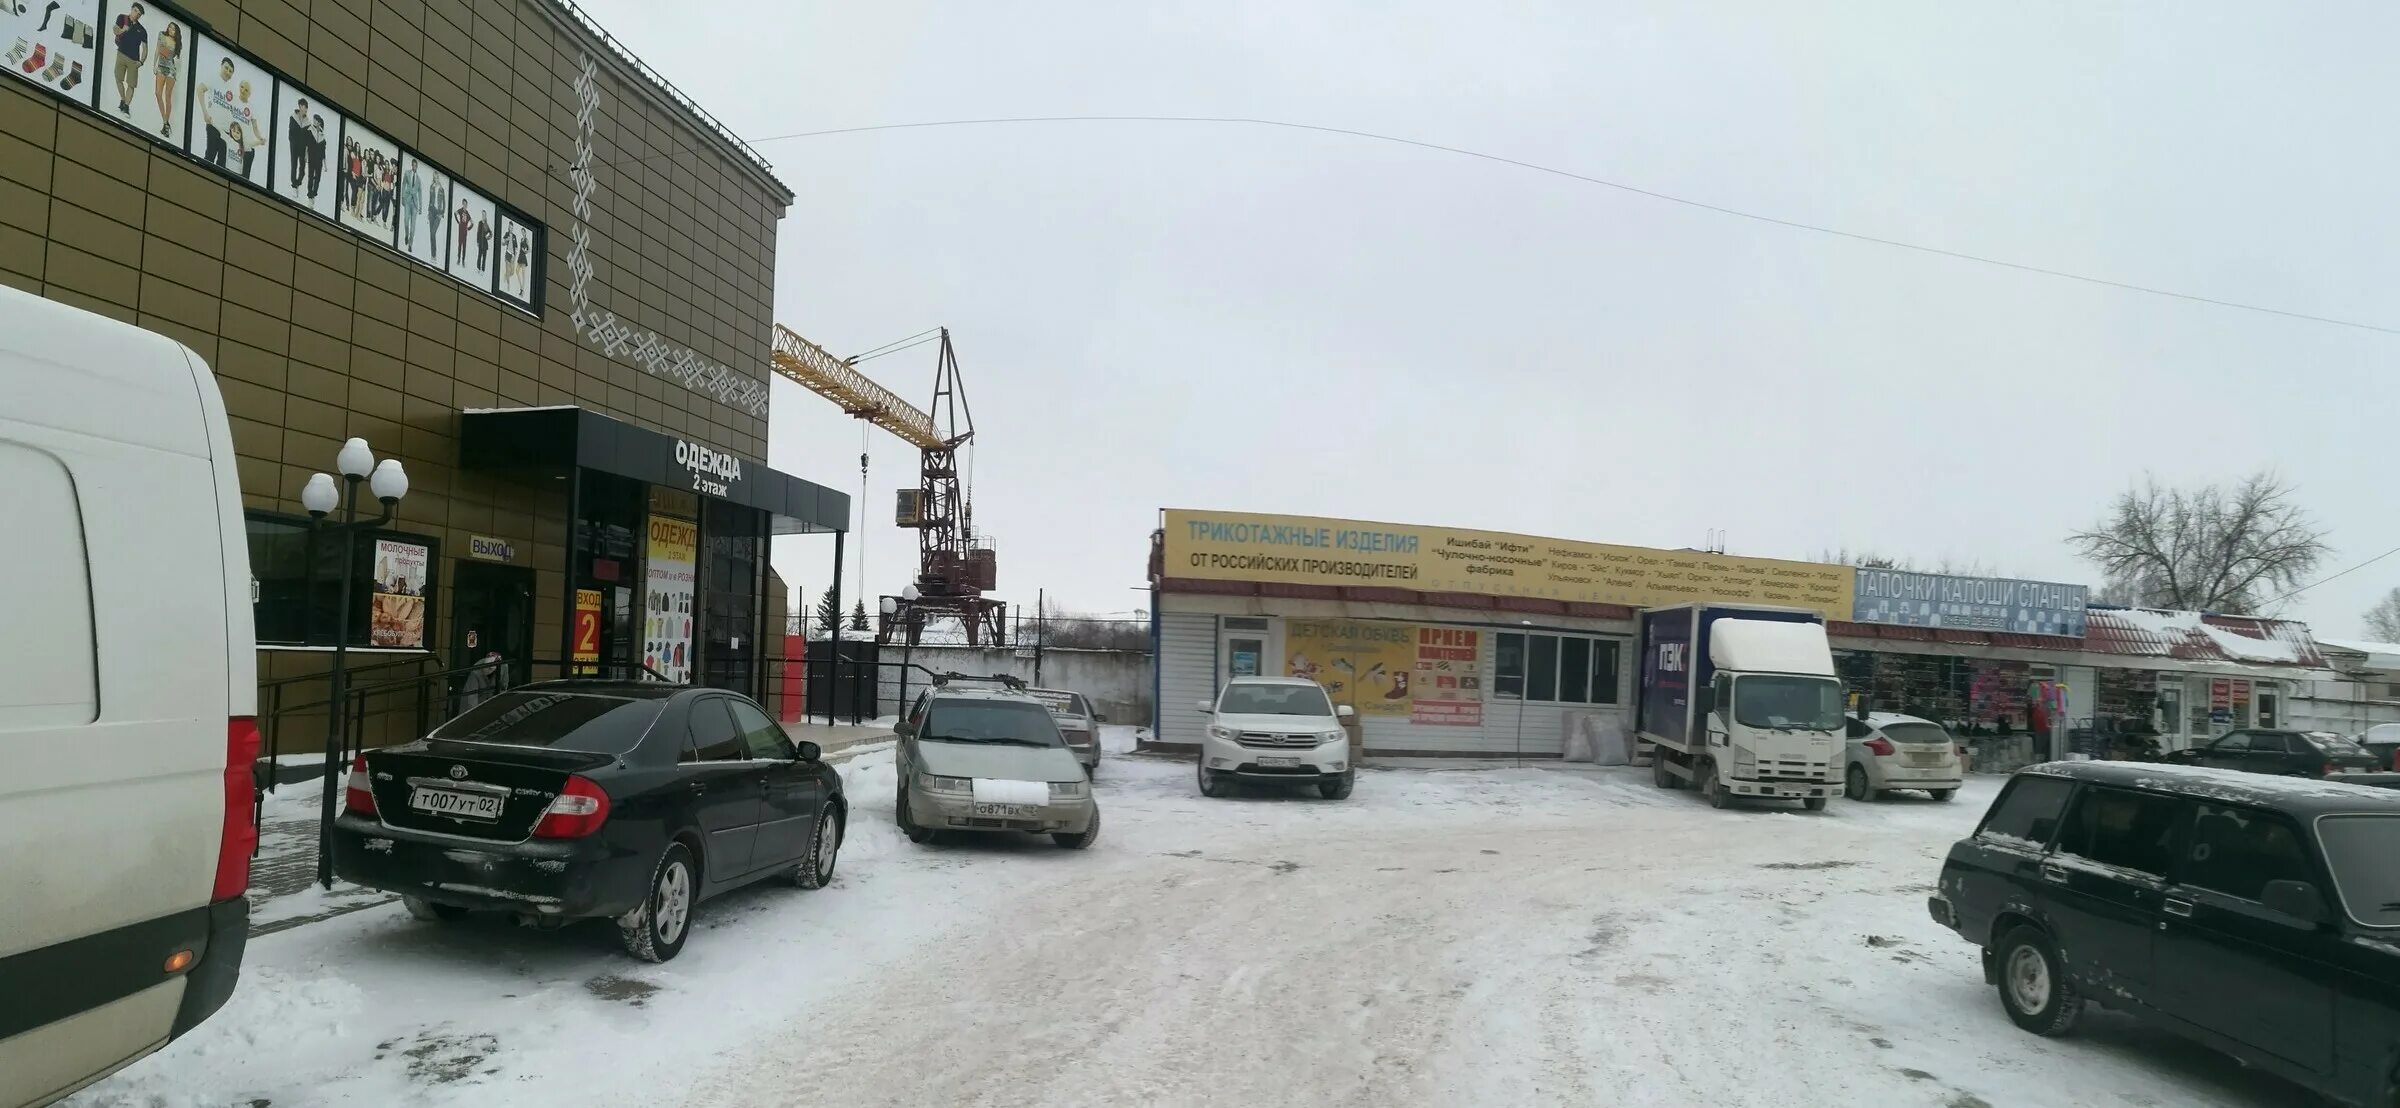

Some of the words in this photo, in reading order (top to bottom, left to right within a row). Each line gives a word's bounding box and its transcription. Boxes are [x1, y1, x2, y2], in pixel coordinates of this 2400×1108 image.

[675, 439, 741, 482] ОДЕЖДА
[693, 474, 700, 490] 2
[701, 480, 728, 498] этаж
[651, 521, 696, 551] ОДЕЖД
[1187, 520, 1331, 548] ТРИКОТАЖНЫЕ
[1336, 529, 1419, 555] ИЗДЕЛИЯ
[1446, 537, 1491, 550] Ишибай
[380, 543, 425, 557] МОЛОЧНЫЕ
[473, 540, 512, 561] ВЫХОД
[1190, 553, 1207, 568] ОТ
[1211, 552, 1300, 573] РОССИЙСКИХ
[1302, 559, 1418, 580] ПРОИЗВОДИТЕЛЕЙ
[1466, 564, 1514, 577] фабрика
[576, 591, 600, 607] ВХОД
[1857, 570, 1936, 600] ТАПОЧКИ
[1941, 577, 2014, 606] КАЛОШИ
[2018, 583, 2087, 611] СЛАНЦЫ
[580, 613, 595, 651] 2
[1291, 622, 1357, 640] ДЕТСКАЯ
[1360, 626, 1410, 643] ОБУВЬ
[1659, 643, 1684, 672] ПЭК
[421, 792, 476, 813] Т007УТ
[479, 798, 494, 812] 02
